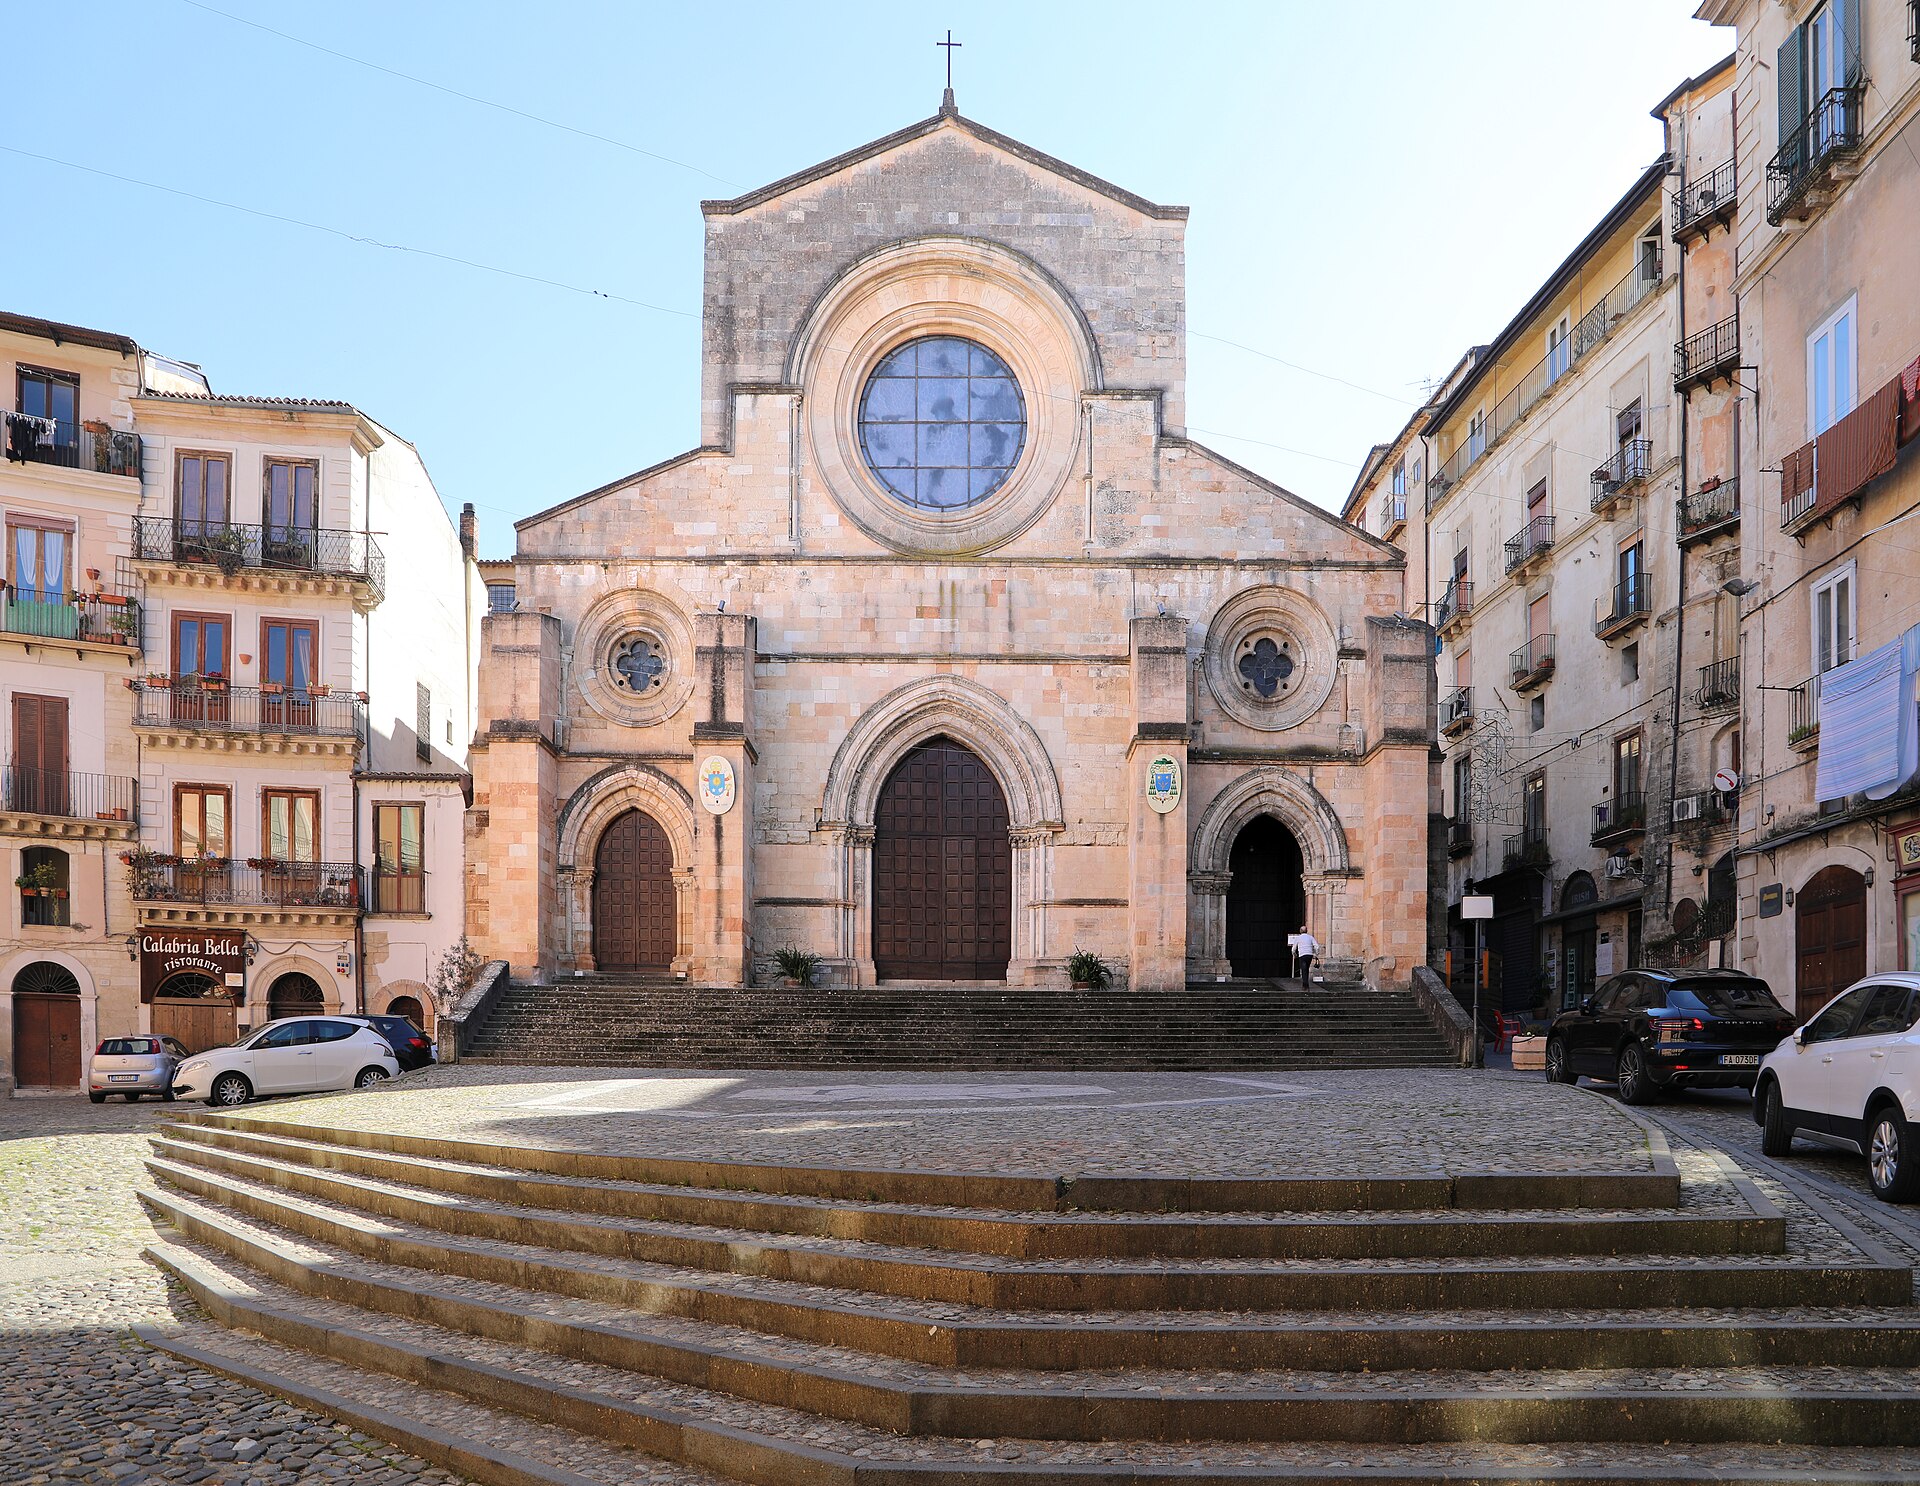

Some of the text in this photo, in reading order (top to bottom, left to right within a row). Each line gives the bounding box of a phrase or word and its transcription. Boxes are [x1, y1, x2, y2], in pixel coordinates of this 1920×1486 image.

[959, 281, 1010, 313] ANNO
[1571, 890, 1590, 905] IRISH
[142, 935, 240, 956] Calabria Bella
[164, 957, 223, 974] ristorante
